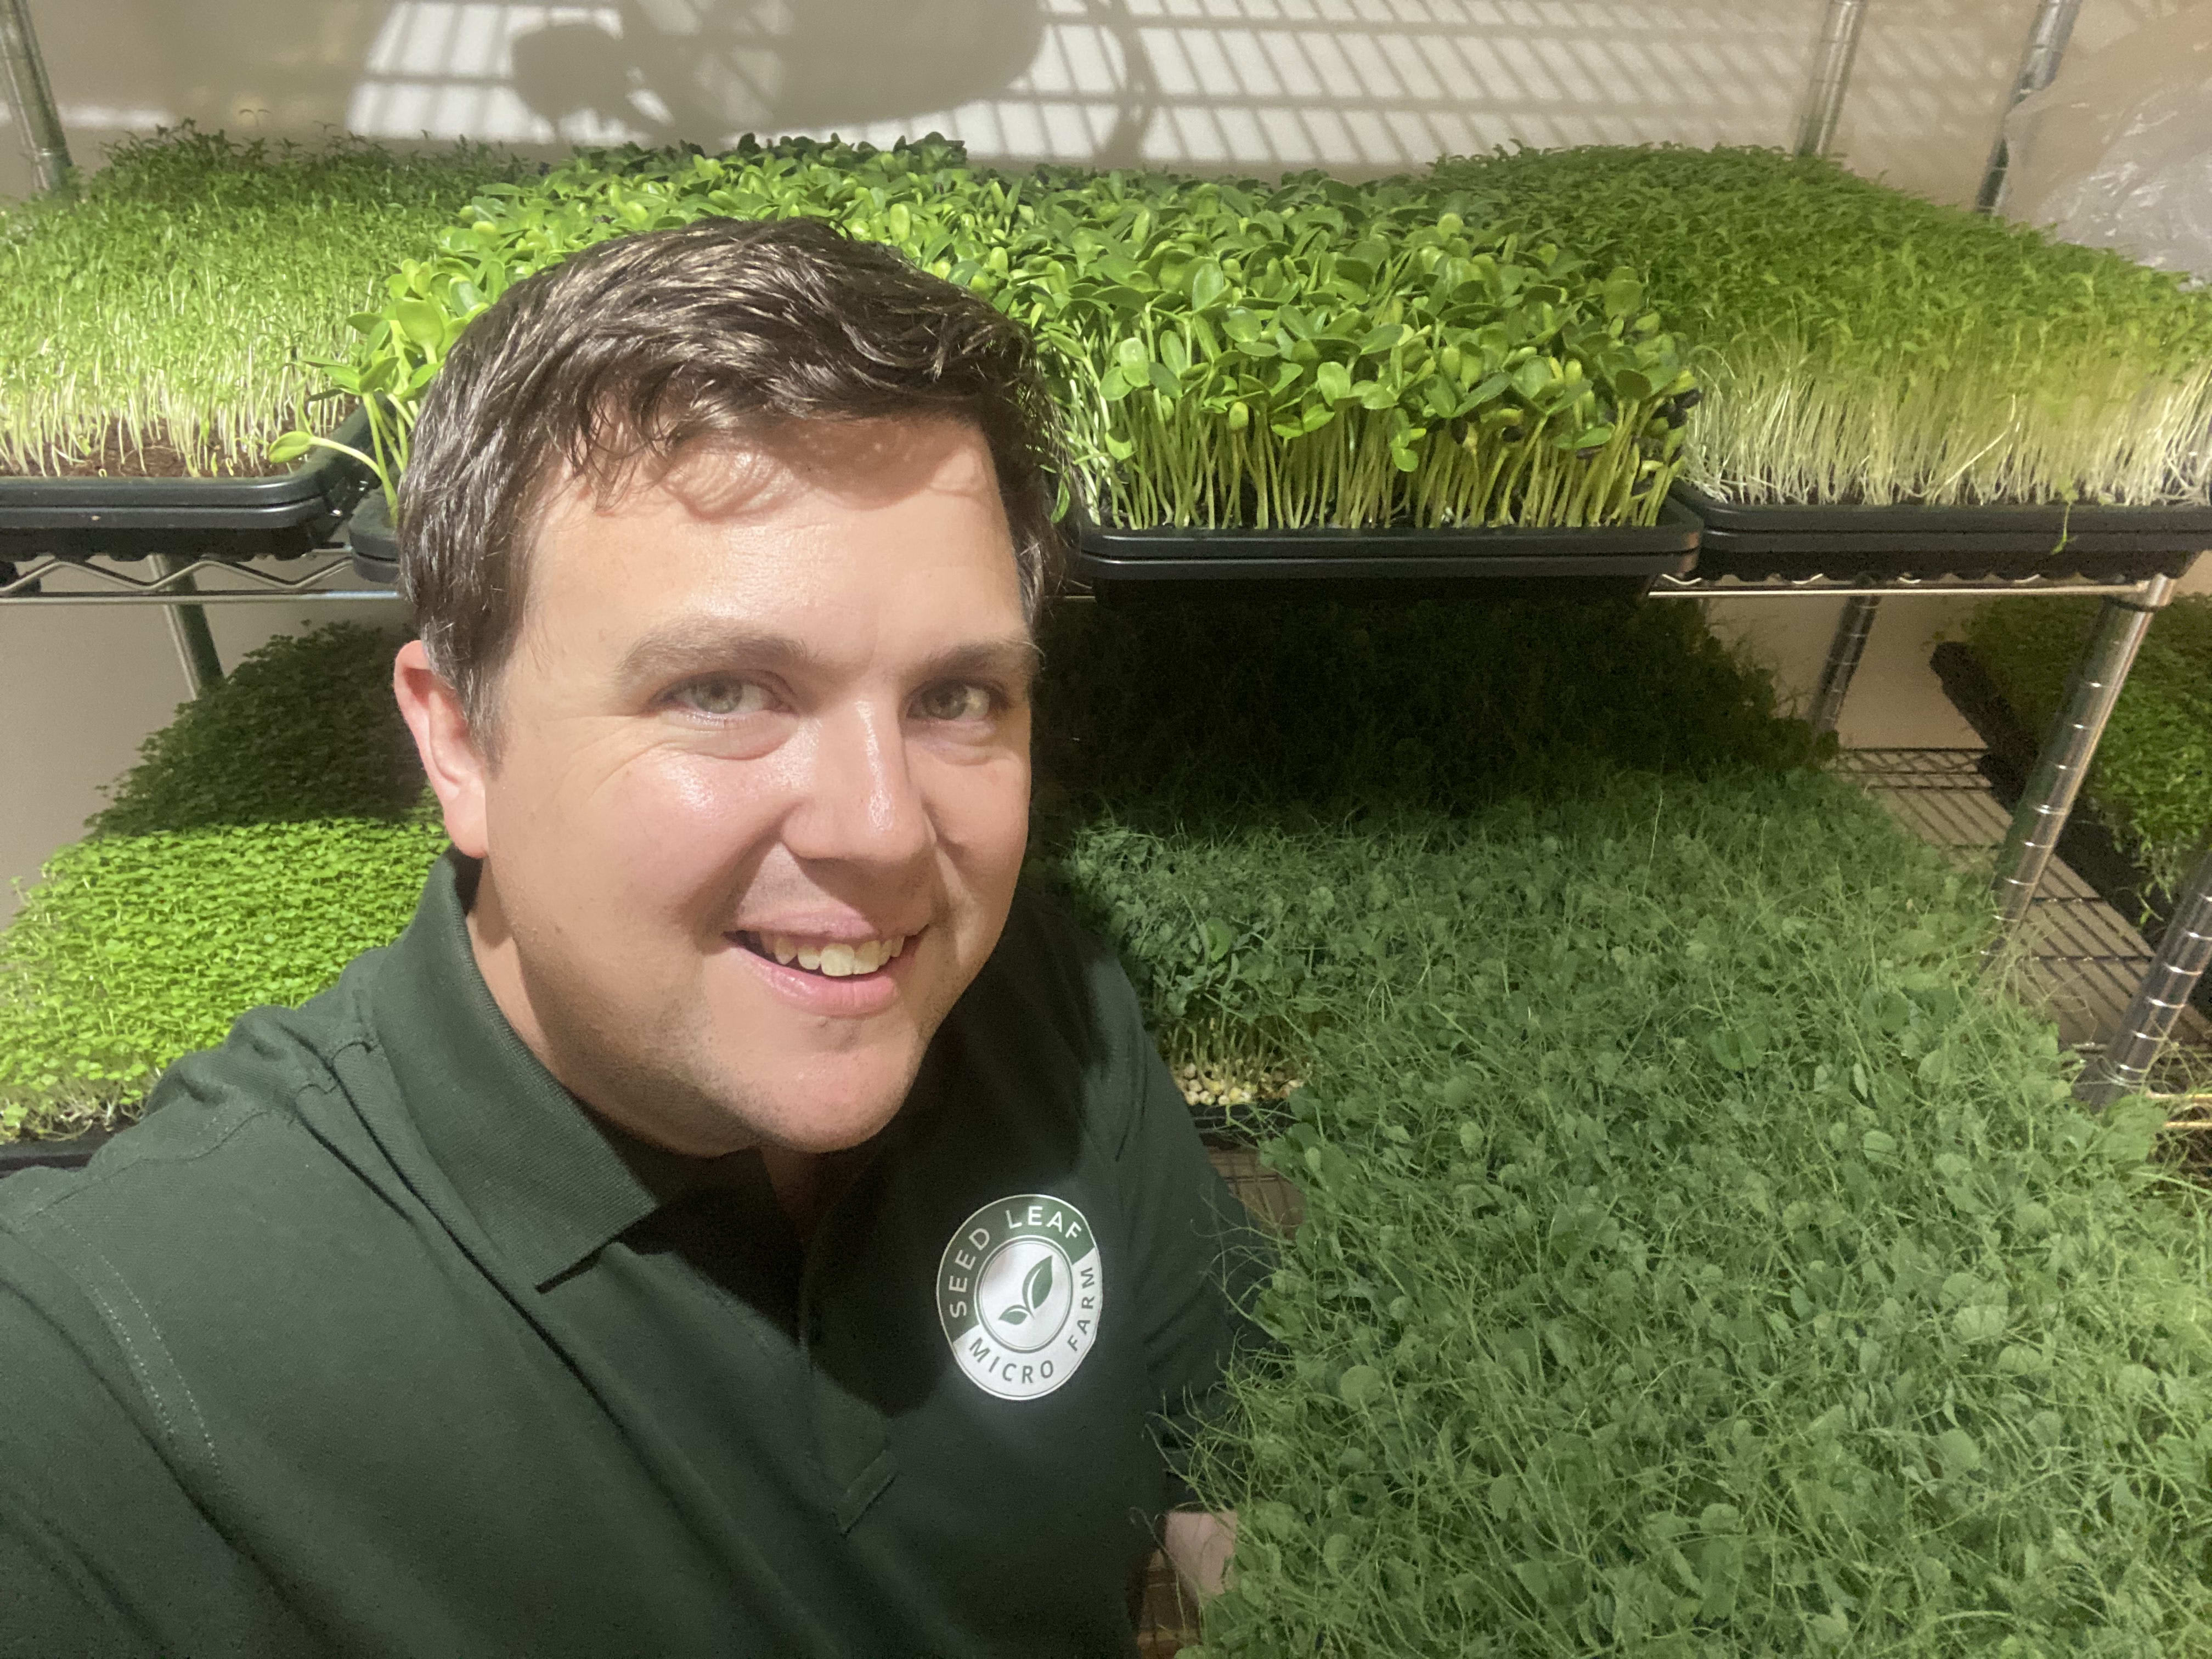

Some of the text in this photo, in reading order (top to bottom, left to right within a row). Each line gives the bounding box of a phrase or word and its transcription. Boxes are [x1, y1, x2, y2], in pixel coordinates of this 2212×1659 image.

[949, 1206, 1082, 1318] SEED LEAF
[969, 1267, 1095, 1384] MICRO FARM
